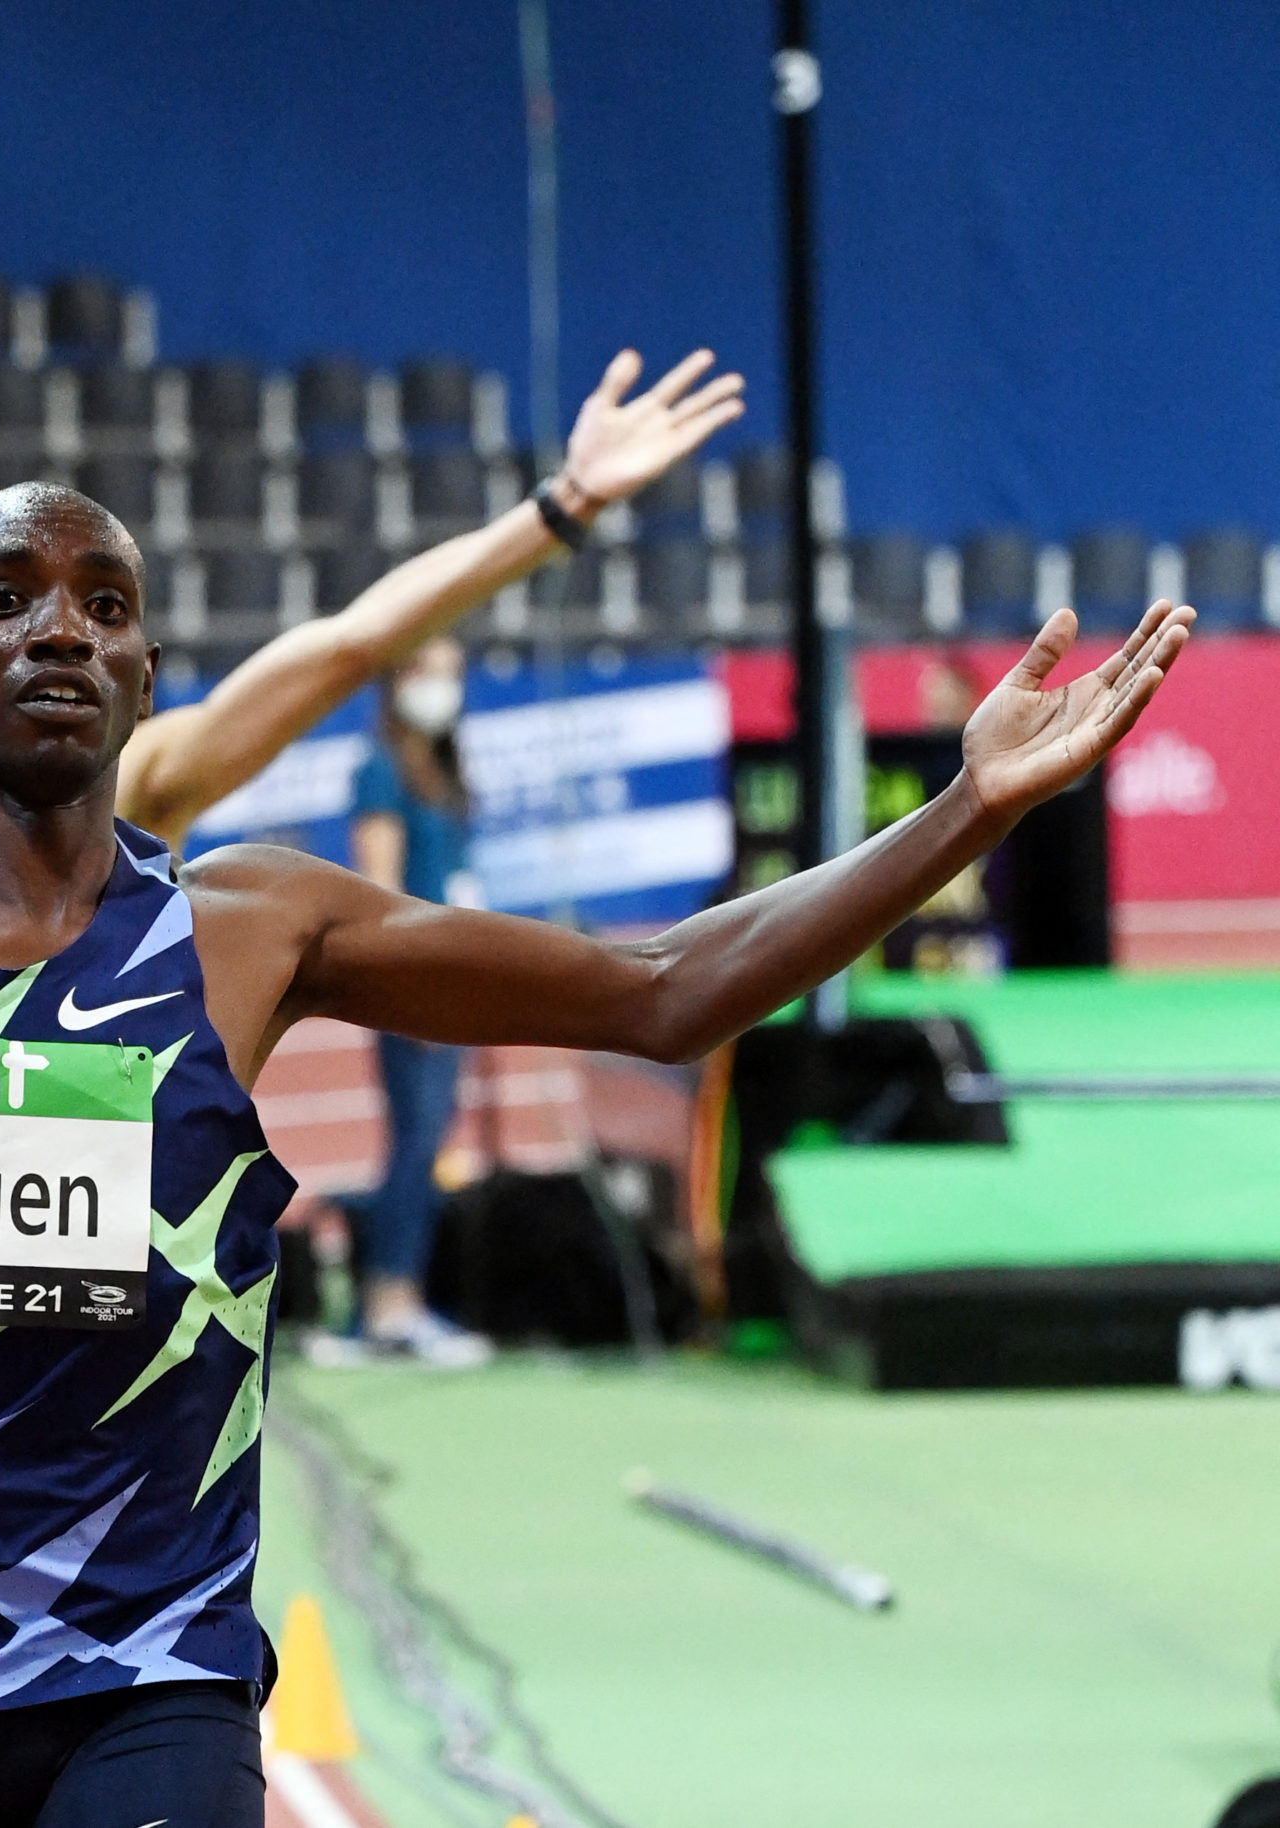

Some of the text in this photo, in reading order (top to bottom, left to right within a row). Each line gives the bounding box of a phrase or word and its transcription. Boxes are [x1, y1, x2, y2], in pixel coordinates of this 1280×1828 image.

[24, 1284, 62, 1313] 21
[80, 1306, 134, 1316] INDOOR TOUR
[97, 1313, 117, 1322] 2021
